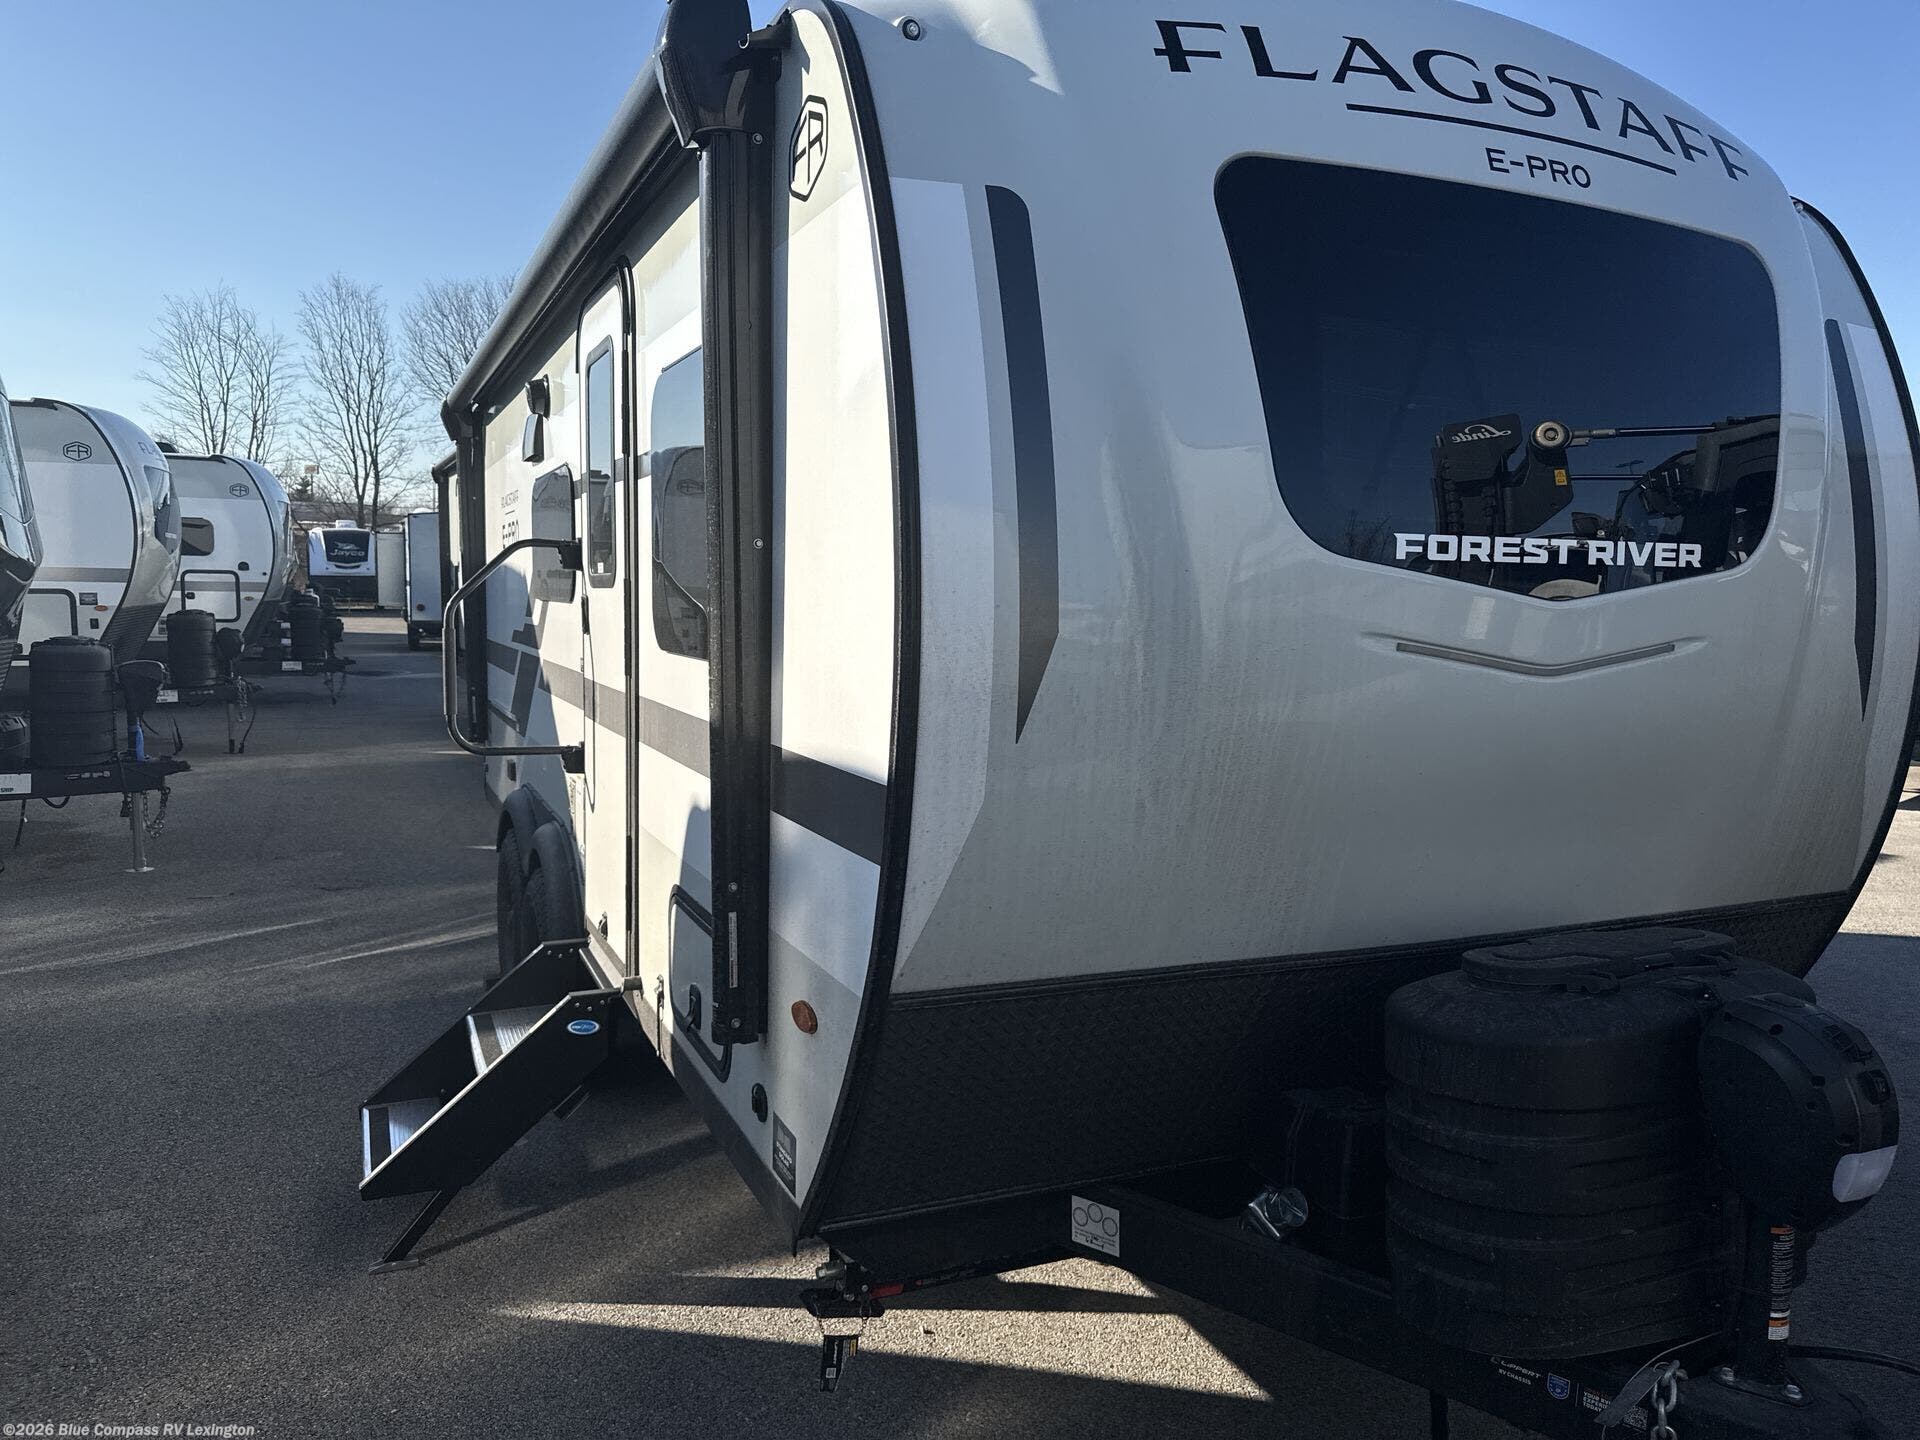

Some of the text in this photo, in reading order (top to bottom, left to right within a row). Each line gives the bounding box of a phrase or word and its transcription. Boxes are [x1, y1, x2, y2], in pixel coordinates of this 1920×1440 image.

[1153, 19, 1749, 182] FLAGSTAFF
[1485, 147, 1592, 189] E-PRO
[329, 549, 365, 557] Jayco
